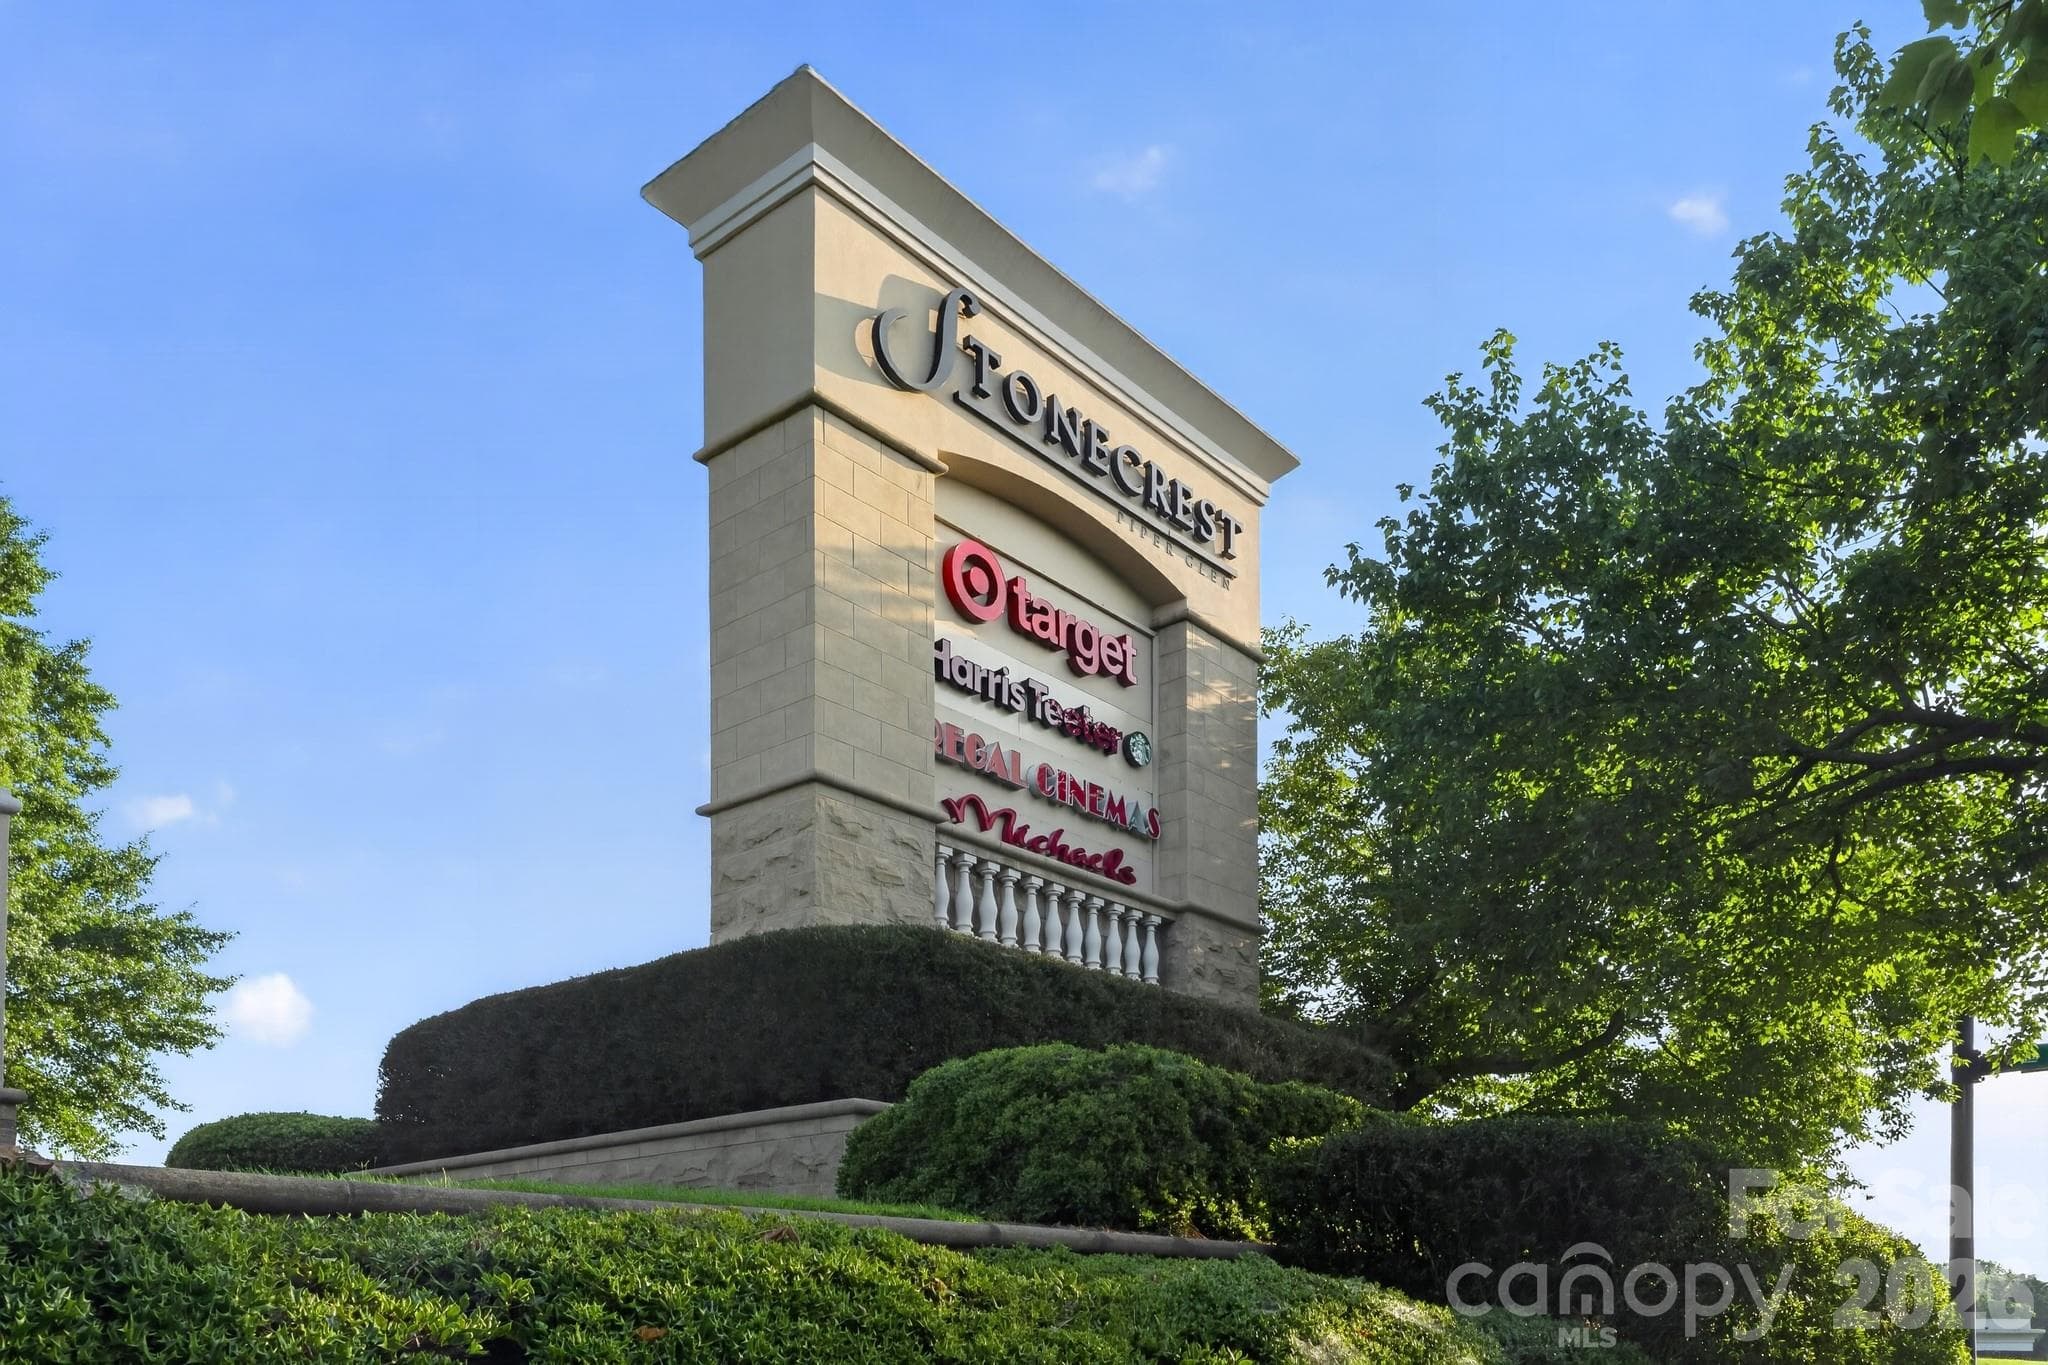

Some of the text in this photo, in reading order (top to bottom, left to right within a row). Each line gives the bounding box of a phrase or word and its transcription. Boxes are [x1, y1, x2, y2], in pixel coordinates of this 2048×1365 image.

[871, 287, 1243, 560] STONECREST
[1117, 511, 1230, 591] PIPER GLEN
[1007, 576, 1137, 688] target
[941, 793, 1137, 885] Michaels
[1026, 762, 1161, 840] CINEMAS
